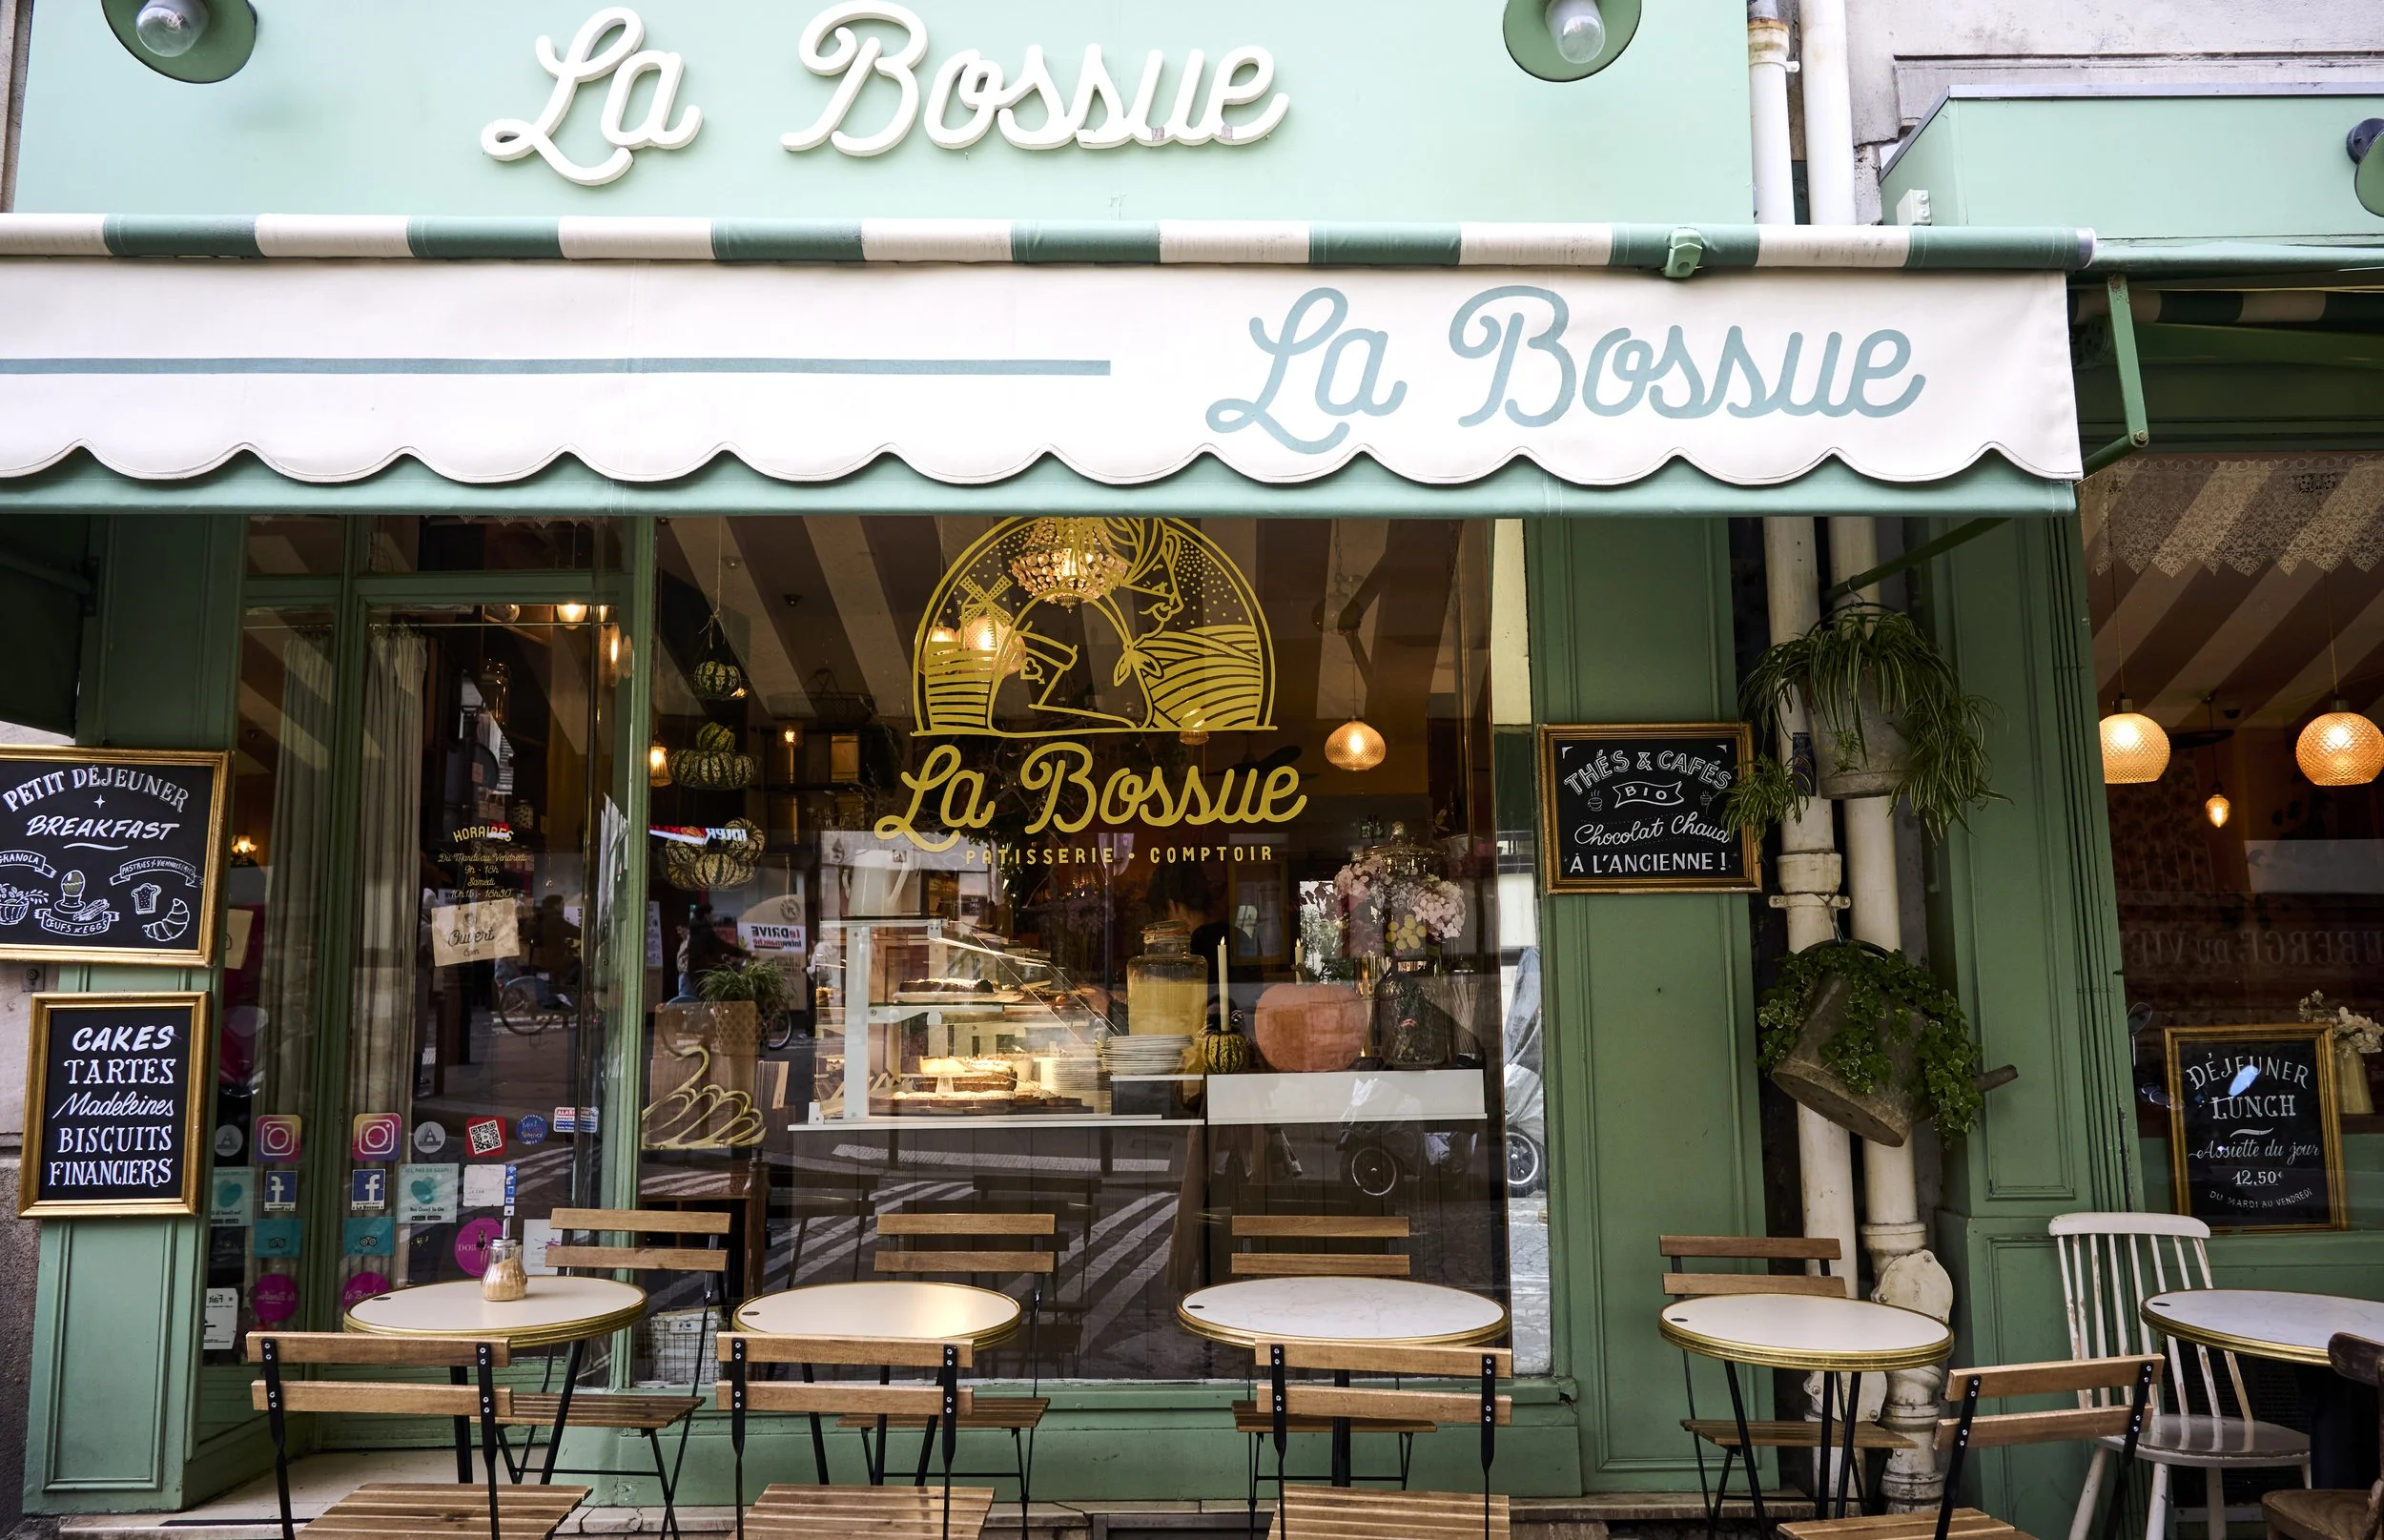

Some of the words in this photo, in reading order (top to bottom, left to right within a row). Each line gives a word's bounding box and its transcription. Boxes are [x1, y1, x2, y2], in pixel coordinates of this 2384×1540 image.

[481, 7, 704, 187] La
[779, 0, 1291, 158] Bossue
[1205, 287, 1408, 454] La
[1449, 285, 1926, 428] Bossue
[1563, 749, 1631, 795] THÉS
[1636, 751, 1654, 770] &
[1657, 750, 1733, 790] CAFÉS
[3, 770, 65, 812] PETIT
[72, 765, 189, 812] DÉJEUNER
[873, 744, 996, 852] La
[1020, 741, 1308, 834] Bossue
[1624, 785, 1668, 800] BIO
[26, 814, 180, 841] BREAKFAST
[453, 825, 514, 843] HORAIRES
[1574, 818, 1665, 846] Chocolat
[966, 841, 1114, 866] PÂTISSERIE
[1150, 846, 1273, 863] COMPTOIR
[484, 864, 500, 874] 18h
[484, 889, 512, 898] 18h30
[82, 921, 108, 934] EGGS
[72, 1024, 176, 1052] CAKES
[63, 1057, 176, 1084] TARTES
[2186, 1052, 2310, 1090] DÉJEUNER
[51, 1090, 175, 1119] Madeleines
[2211, 1095, 2297, 1119] LUNCH
[57, 1124, 172, 1154] BISCUITS
[2188, 1140, 2260, 1159] Assiette
[2265, 1139, 2284, 1158] du
[2287, 1141, 2321, 1166] jour
[48, 1157, 174, 1188] FINANCIERS
[2209, 1190, 2224, 1201] DU
[2228, 1198, 2259, 1208] MARDI
[2261, 1200, 2273, 1208] AU
[2275, 1187, 2313, 1206] VENDREDI
